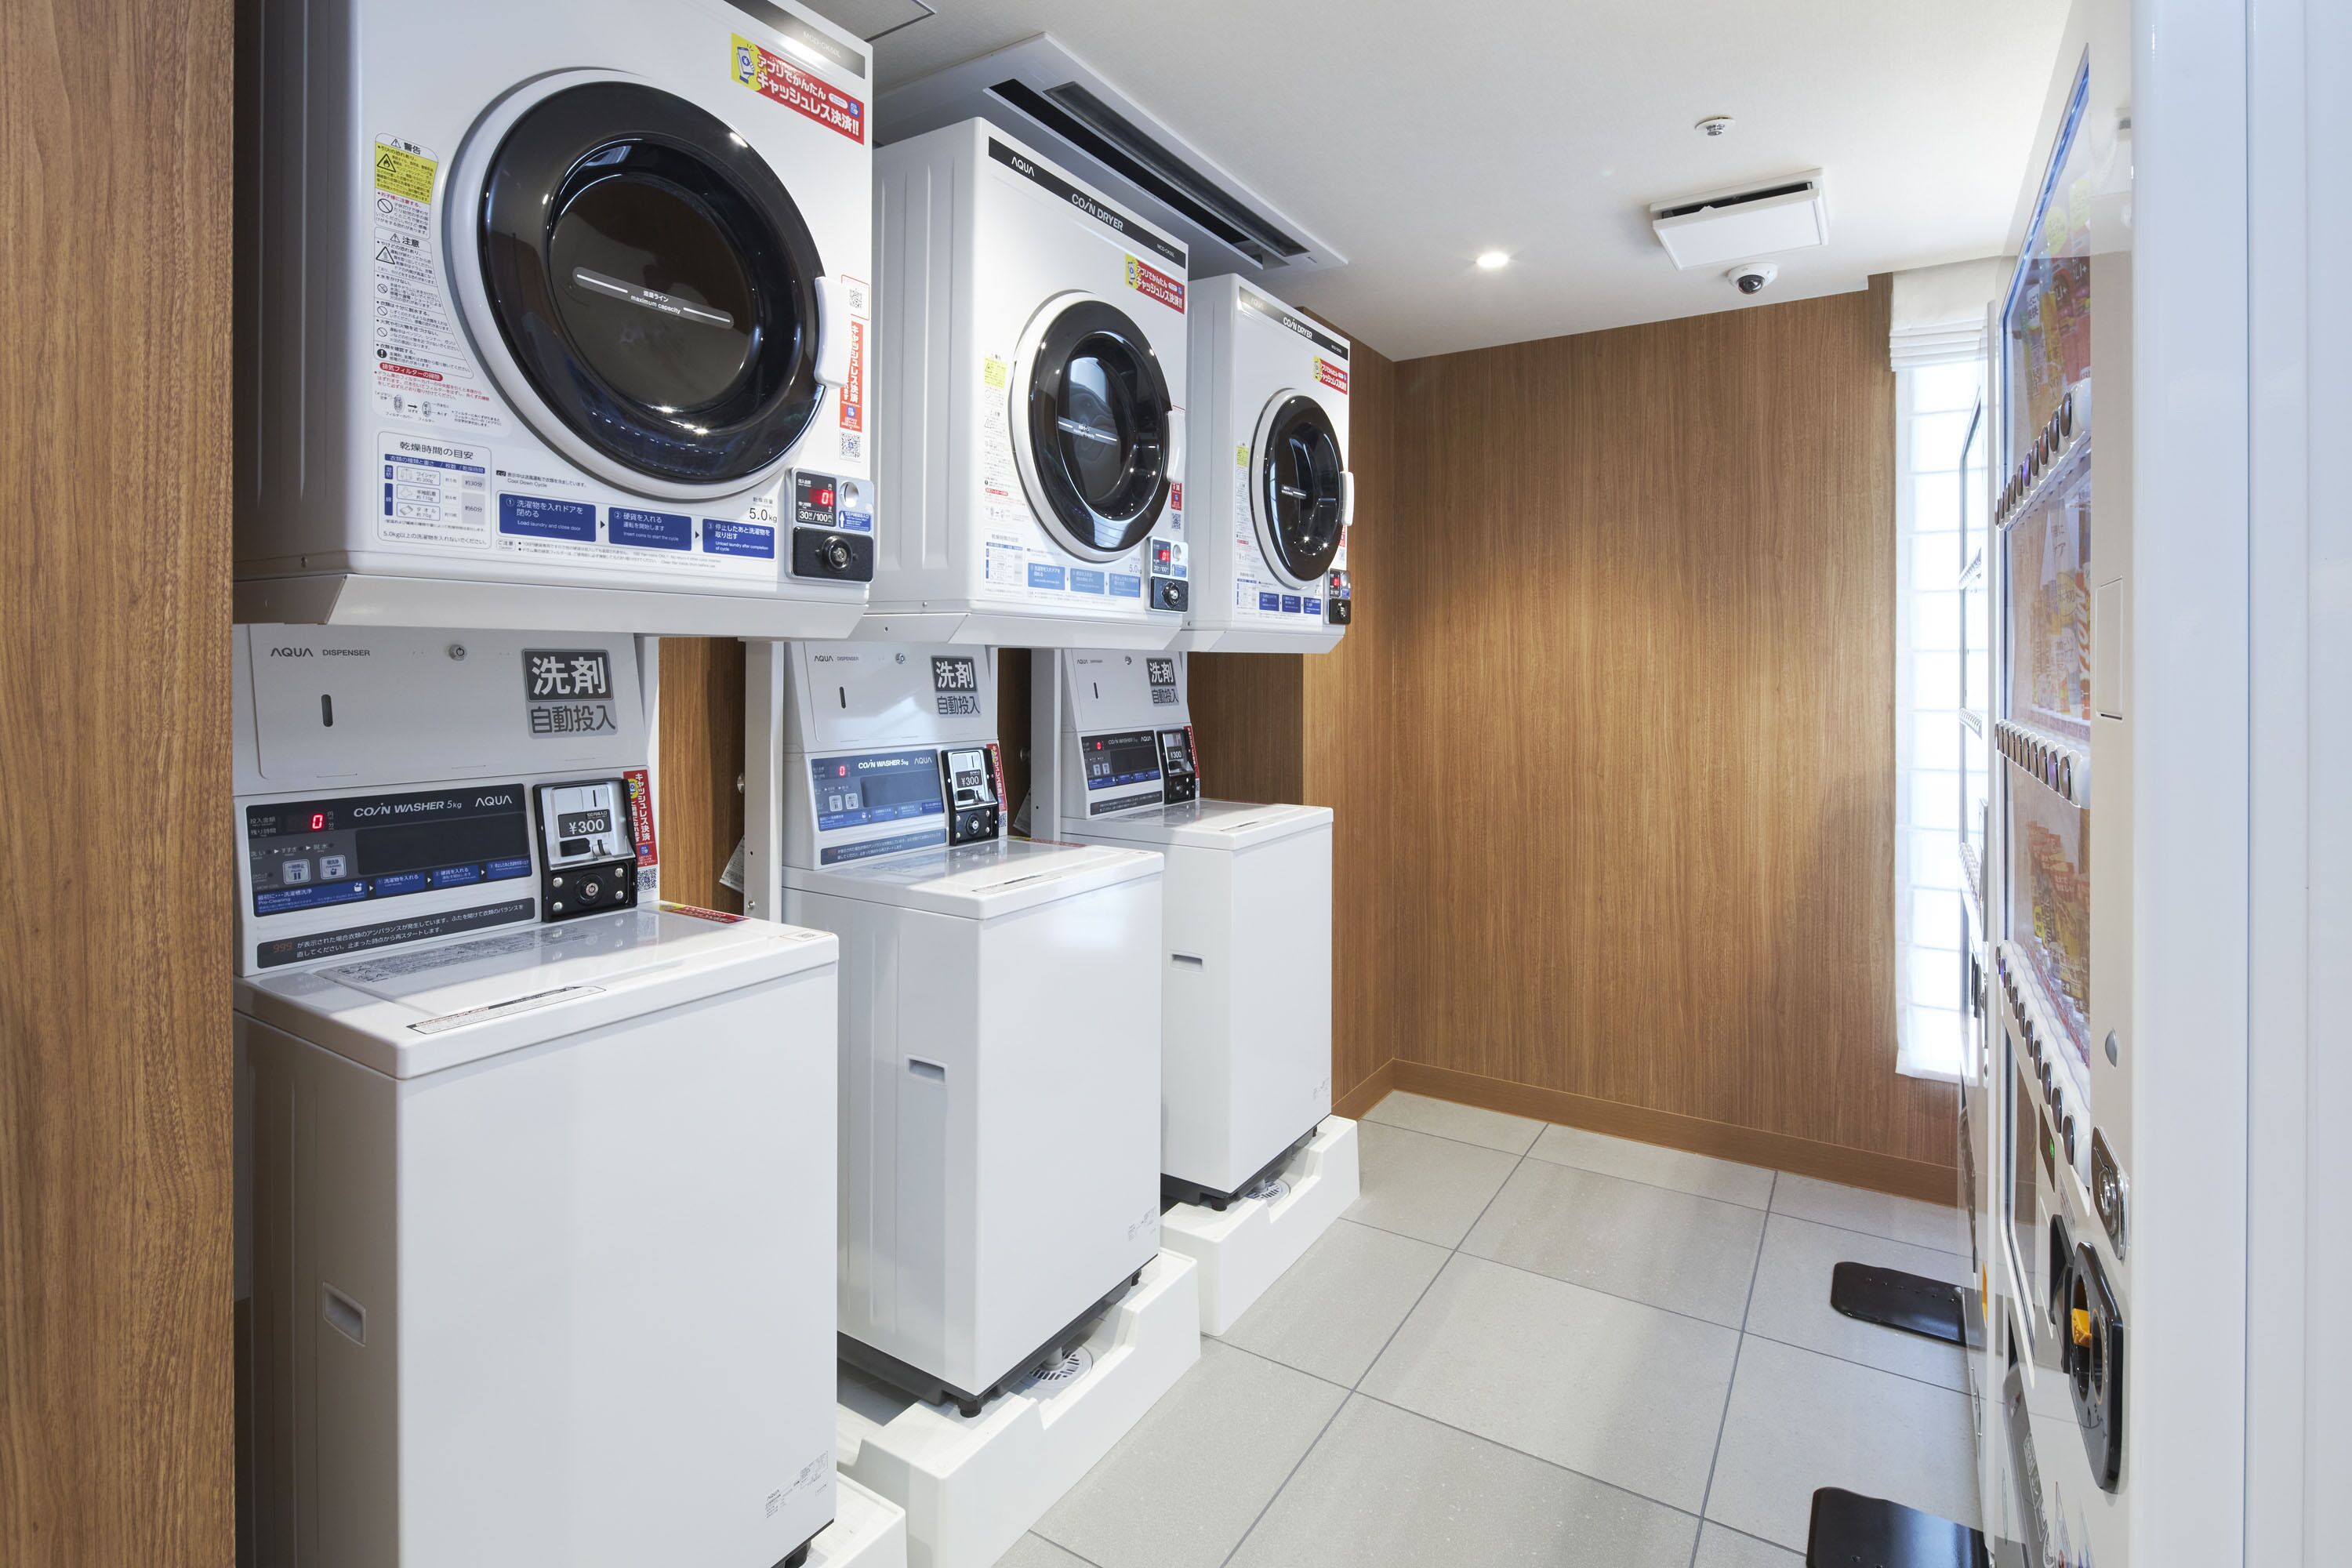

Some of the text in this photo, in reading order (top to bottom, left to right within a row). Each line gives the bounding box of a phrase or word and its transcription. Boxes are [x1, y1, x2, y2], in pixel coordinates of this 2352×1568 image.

[757, 53, 827, 100] アプリでかんたん
[757, 71, 860, 137] キャッシュレス決済!!
[403, 142, 421, 155] 警告
[1011, 156, 1035, 176] AQUA
[1097, 207, 1123, 231] DRYER
[402, 236, 420, 249] 注意
[1137, 265, 1168, 289] アプリでかんたん
[630, 295, 681, 314] maximum capacity
[1297, 325, 1312, 339] DRYER
[400, 441, 474, 460] 乾燥時間の目安
[416, 470, 437, 479] ワイシャツ
[464, 479, 483, 488] 約30分
[821, 492, 829, 505] 0
[516, 499, 583, 514] 洗濯物を入れドアを
[516, 508, 539, 518] 閉める
[623, 512, 662, 524] 硬貨を入れる
[749, 507, 778, 523] 5.0kg
[623, 521, 665, 532] 運転を開始します
[715, 524, 771, 536] 停止したあと洗濯物を
[383, 530, 488, 546] 5.0kg以上の洗濯物を入れないでください。
[715, 532, 738, 540] 取り出す
[270, 647, 314, 658] AQUA
[531, 655, 608, 695] 洗剤
[935, 661, 975, 689] 洗剤
[1149, 662, 1174, 684] 洗剤
[1151, 688, 1179, 704] 自動投入
[936, 695, 981, 715] 自動投入
[530, 705, 616, 734] 自動投入
[838, 765, 846, 776] 0
[876, 759, 901, 768] WASHER
[961, 775, 979, 786] ¥300
[394, 800, 445, 813] WASHER
[446, 800, 462, 809] 5kg
[475, 795, 513, 808] AQUA
[634, 772, 651, 841] キャッシュレス決済
[311, 814, 324, 829] 0
[568, 818, 605, 835] ¥300
[383, 874, 419, 884] 洗濯物を入れる
[441, 867, 470, 876] 硬貨を入れる
[272, 903, 524, 953] 999 が表示された場合衣類のアンバランスが発生しています。ふたを開けて衣類のバランスを
[296, 927, 444, 958] 直してください。止まった時点から再スタートします。
